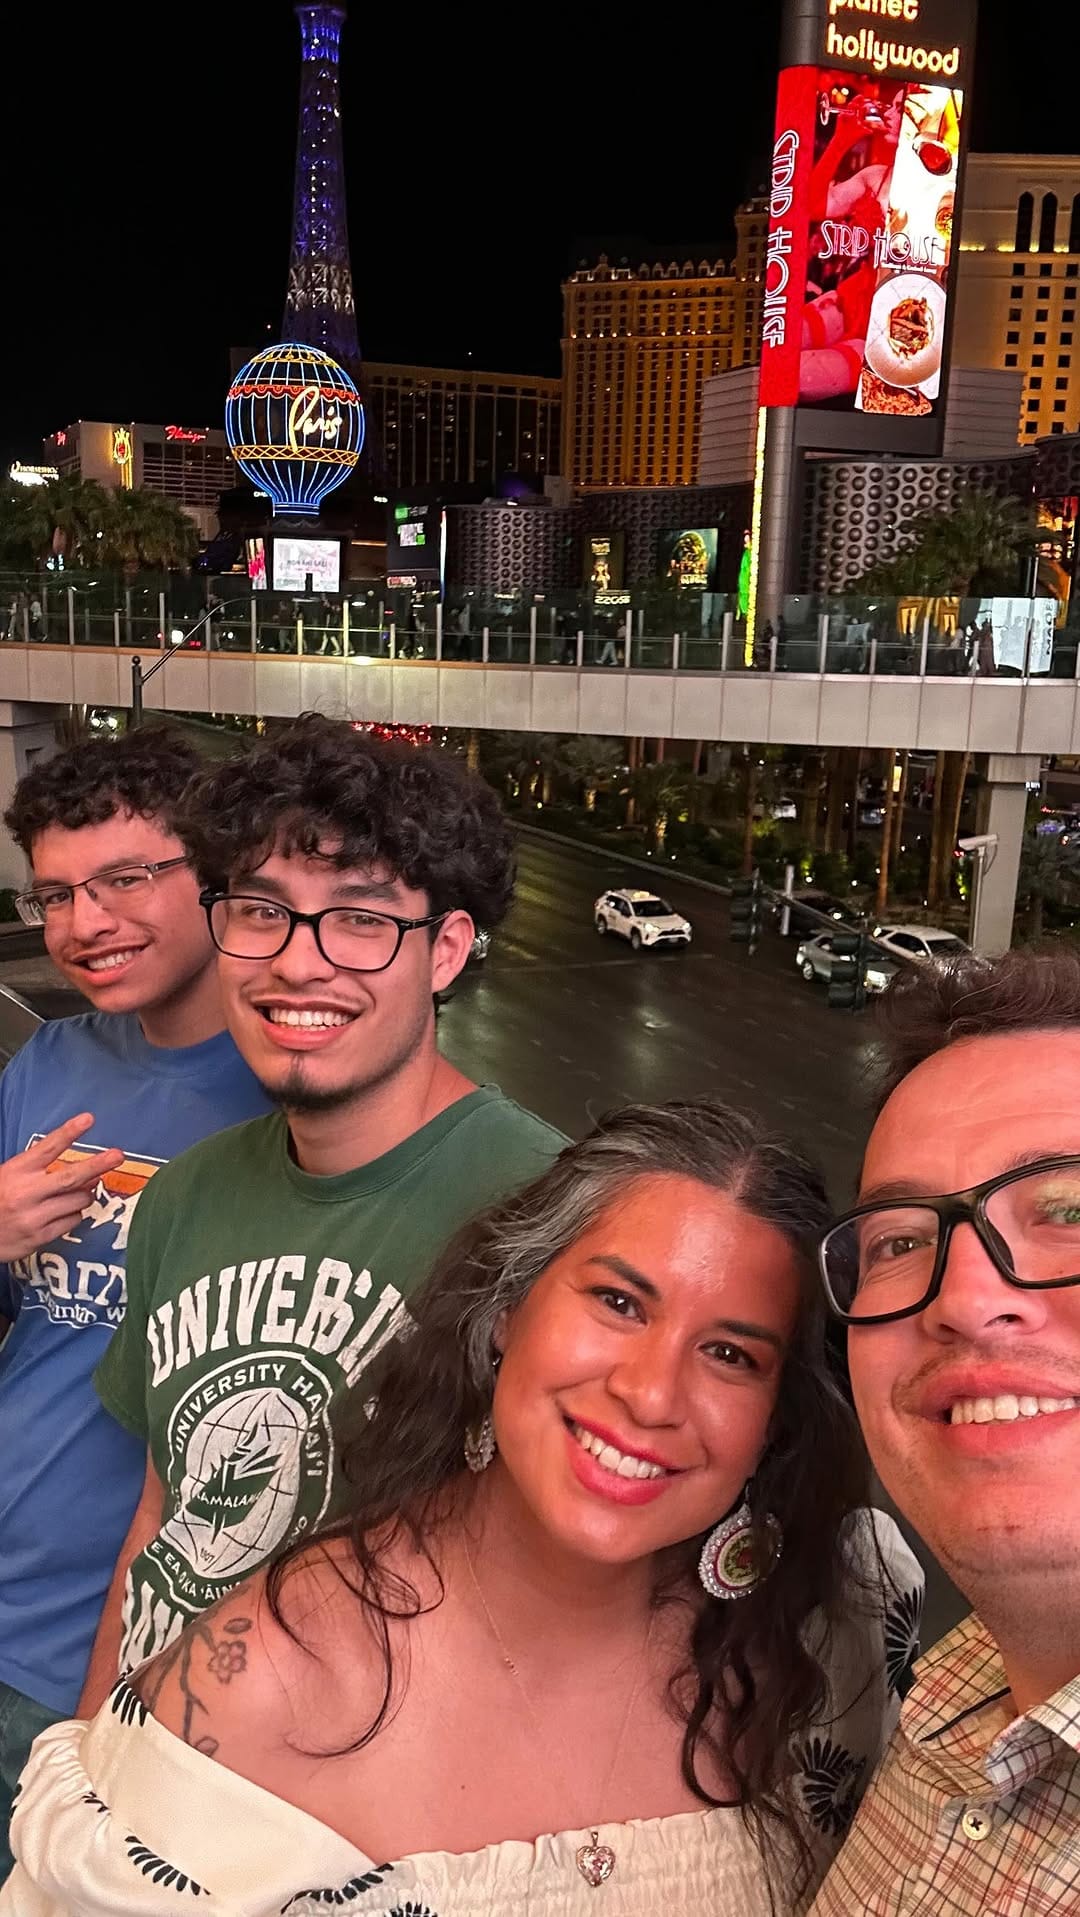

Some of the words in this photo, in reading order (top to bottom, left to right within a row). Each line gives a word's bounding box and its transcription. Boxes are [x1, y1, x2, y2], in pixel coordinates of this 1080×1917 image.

[829, 0, 919, 20] panet
[827, 22, 960, 75] hollywood
[818, 220, 870, 259] STRIP
[873, 227, 940, 269] HOUSE
[288, 386, 343, 453] Paris
[176, 1364, 286, 1454] UNIVERSITY
